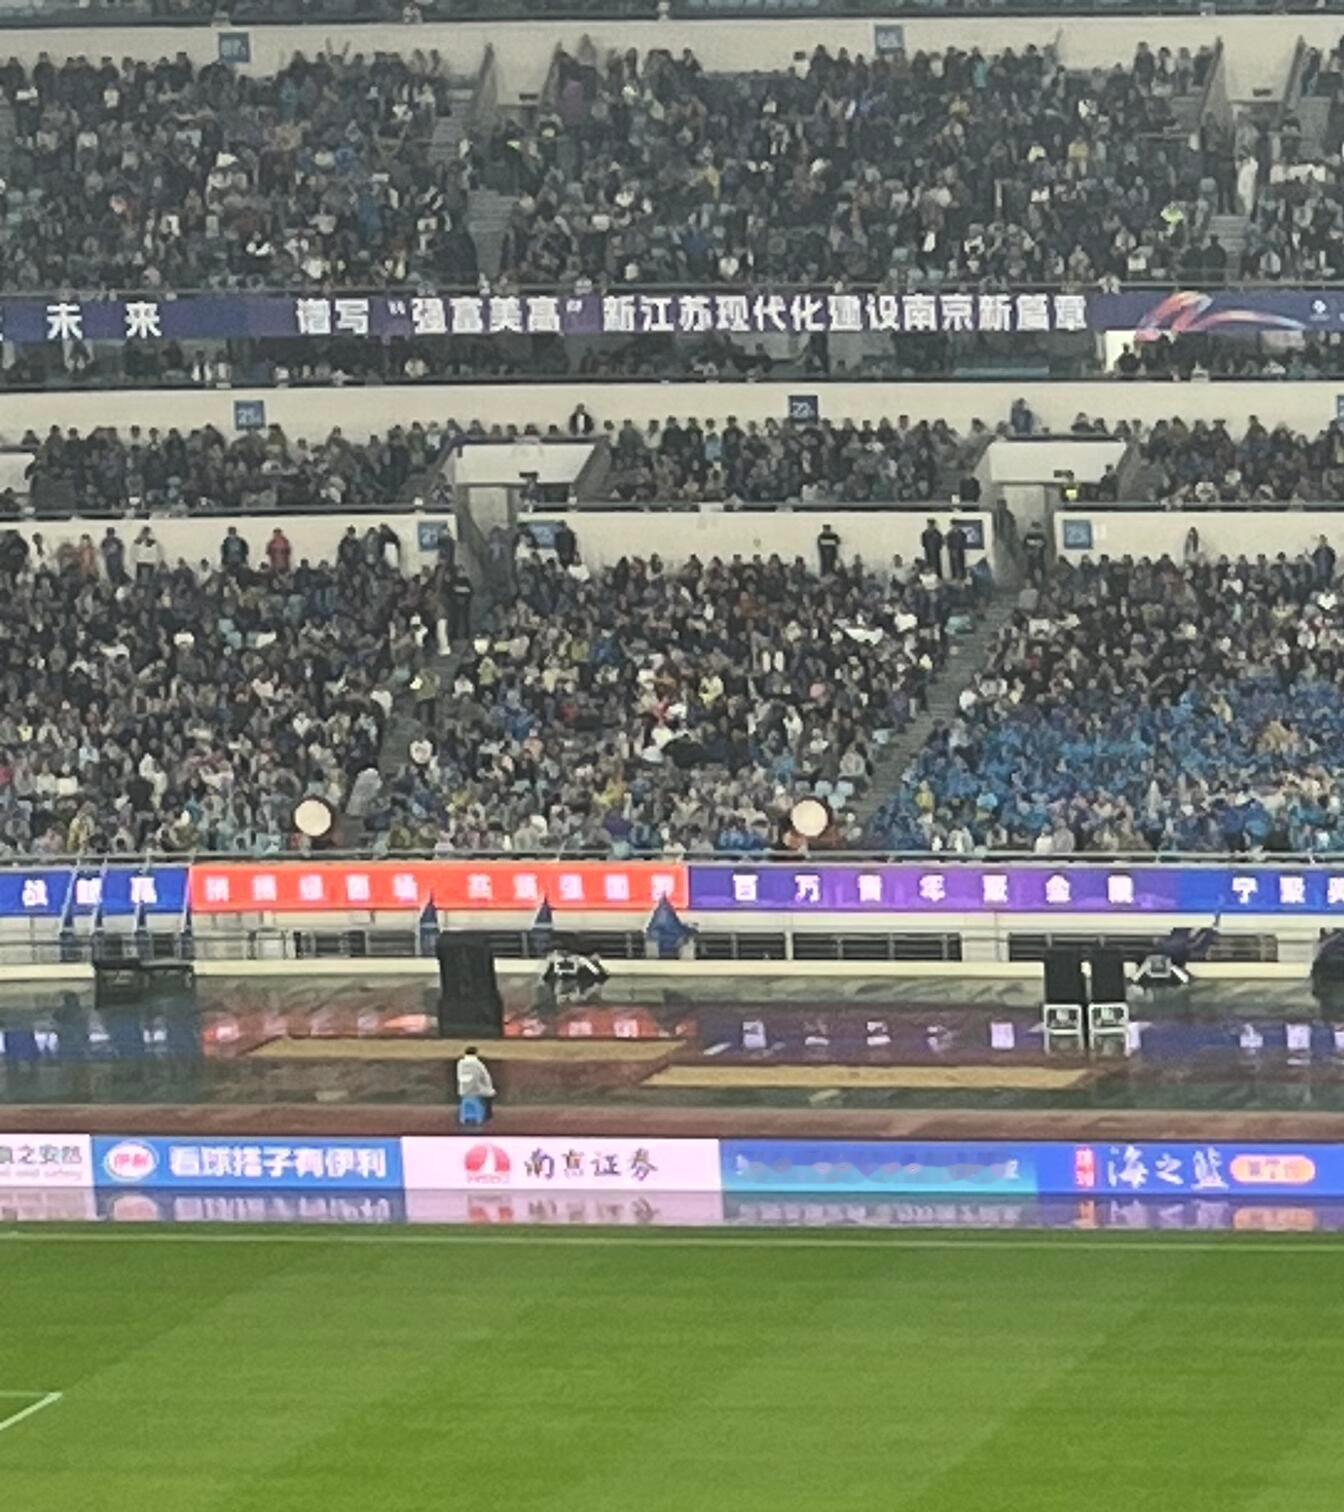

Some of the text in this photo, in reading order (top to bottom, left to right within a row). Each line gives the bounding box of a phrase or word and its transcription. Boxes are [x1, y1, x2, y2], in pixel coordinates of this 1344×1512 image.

[169, 1146, 387, 1180] 看球搭子有伊利
[524, 1147, 658, 1180] 南京证券
